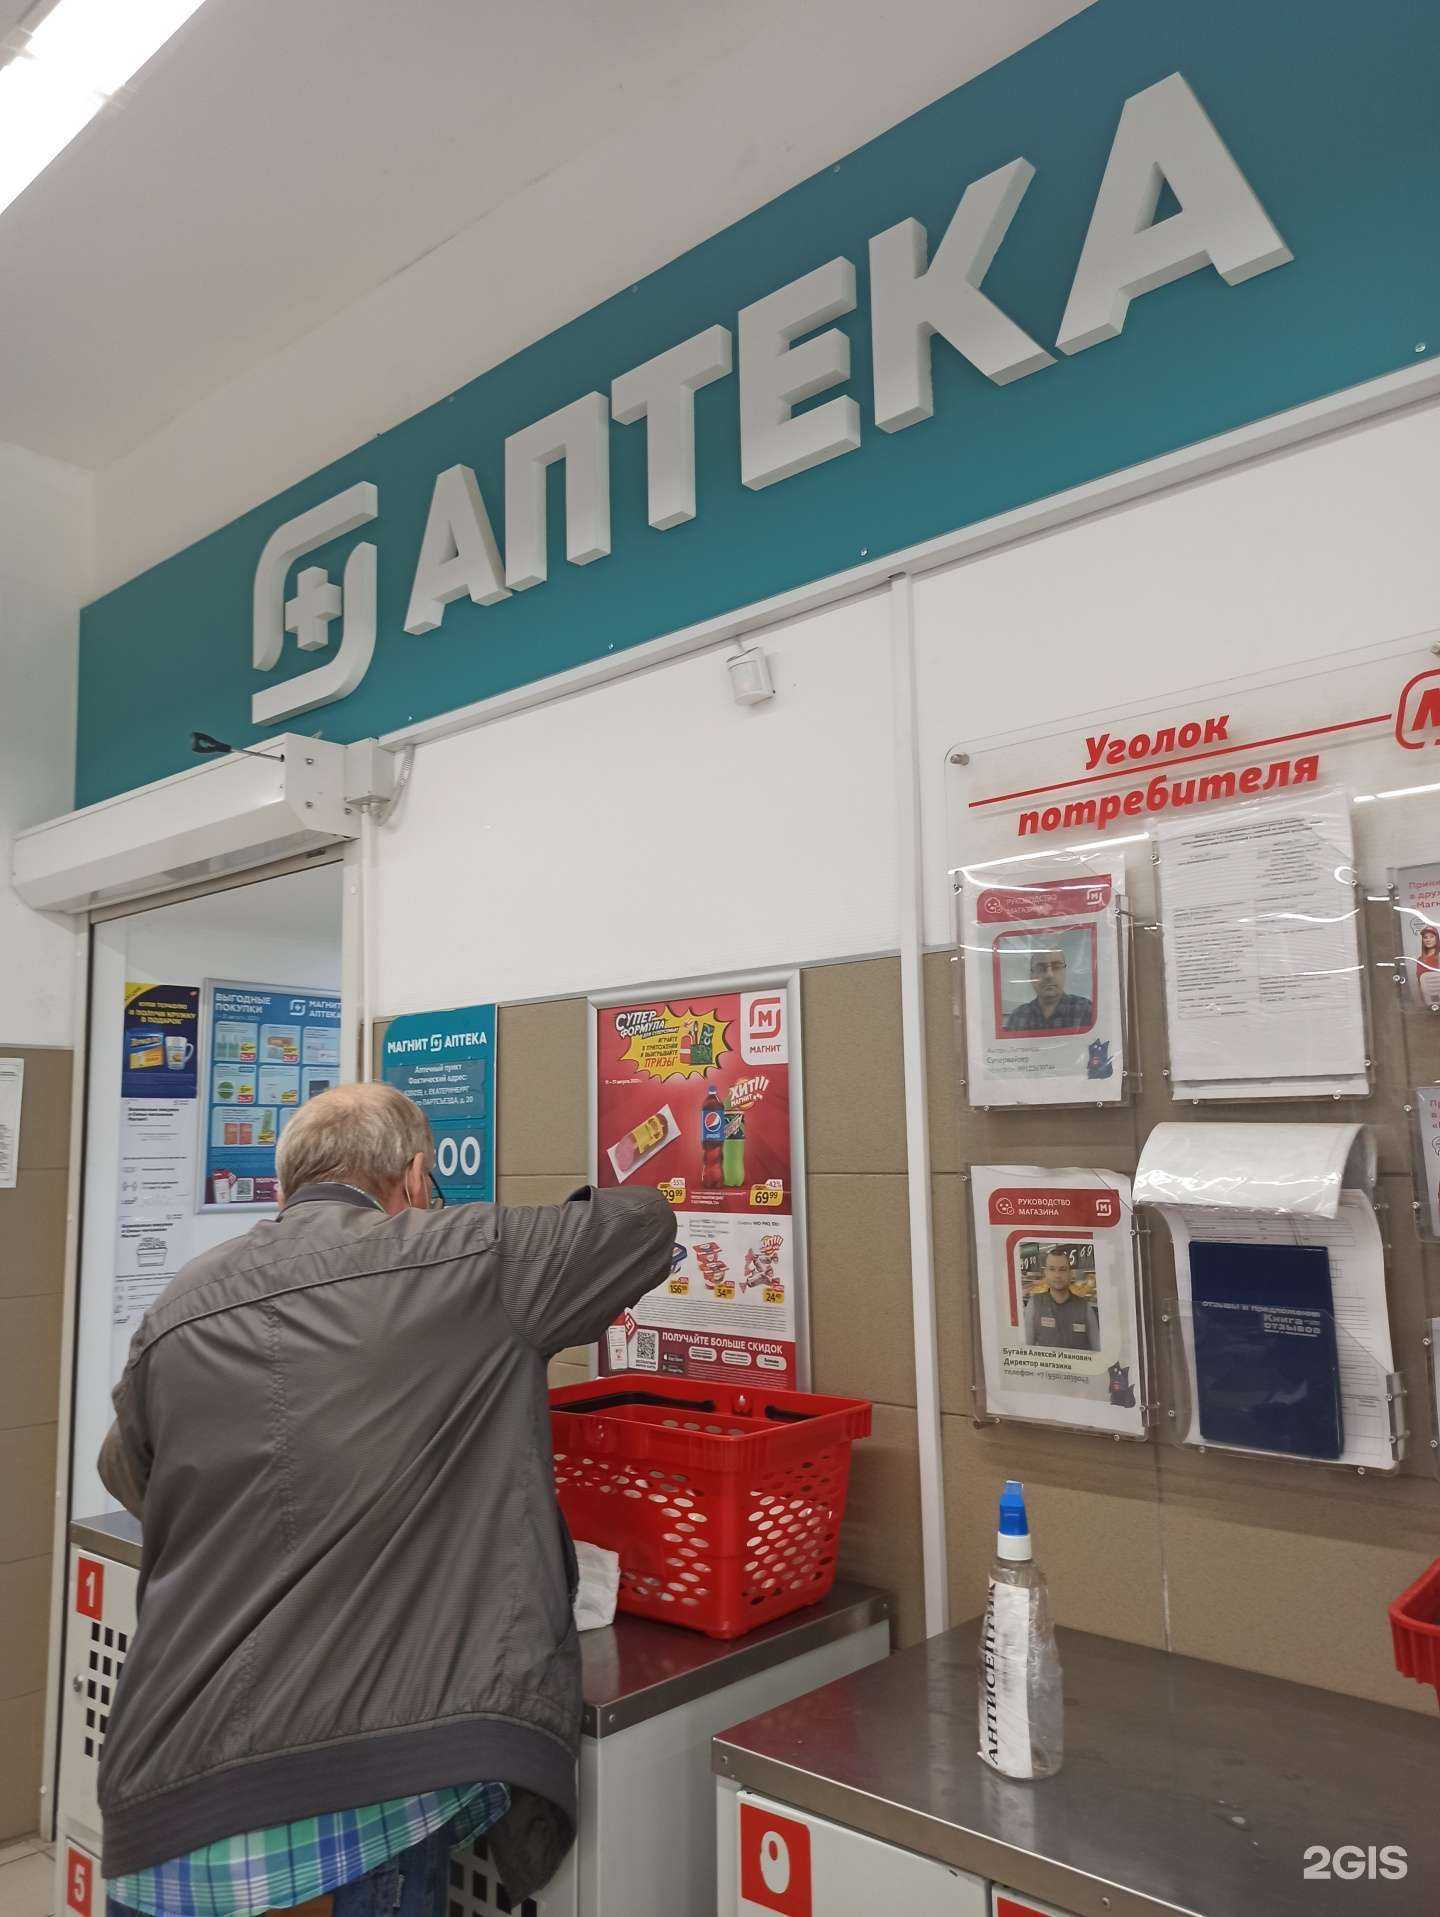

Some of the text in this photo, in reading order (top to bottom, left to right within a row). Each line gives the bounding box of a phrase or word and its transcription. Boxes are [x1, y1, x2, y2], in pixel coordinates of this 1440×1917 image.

[404, 72, 1294, 635] АПТЕКА
[1085, 714, 1230, 770] Уголок
[1018, 754, 1320, 837] потребителя
[215, 992, 271, 1005] ВЫГОДНЫЕ
[308, 1000, 342, 1010] МАГНИТ
[215, 1003, 263, 1014] ПОКУПКИ
[616, 1010, 657, 1031] СУПЕР
[620, 1020, 665, 1039] ФОРМУЛА
[388, 1031, 488, 1053] МАГНИТ АПТЕКА
[750, 1044, 781, 1055] МАГНИТ
[755, 1191, 768, 1204] 69
[769, 1191, 778, 1199] 99
[1018, 1198, 1071, 1207] РУКОВОДСТВО
[1018, 1208, 1060, 1217] МАГАЗИНА
[1264, 1313, 1303, 1325] Книга
[662, 1331, 784, 1355] ПОЛУЧАЙТЕ БОЛЬШЕ СКИДОК
[1028, 1349, 1057, 1359] Алексей
[1057, 1352, 1093, 1362] Иванович
[1003, 1357, 1072, 1371] Директор магазина
[86, 1570, 95, 1608] 1
[983, 1582, 999, 1767] АНТИСЕПТИК
[73, 1863, 87, 1902] 5
